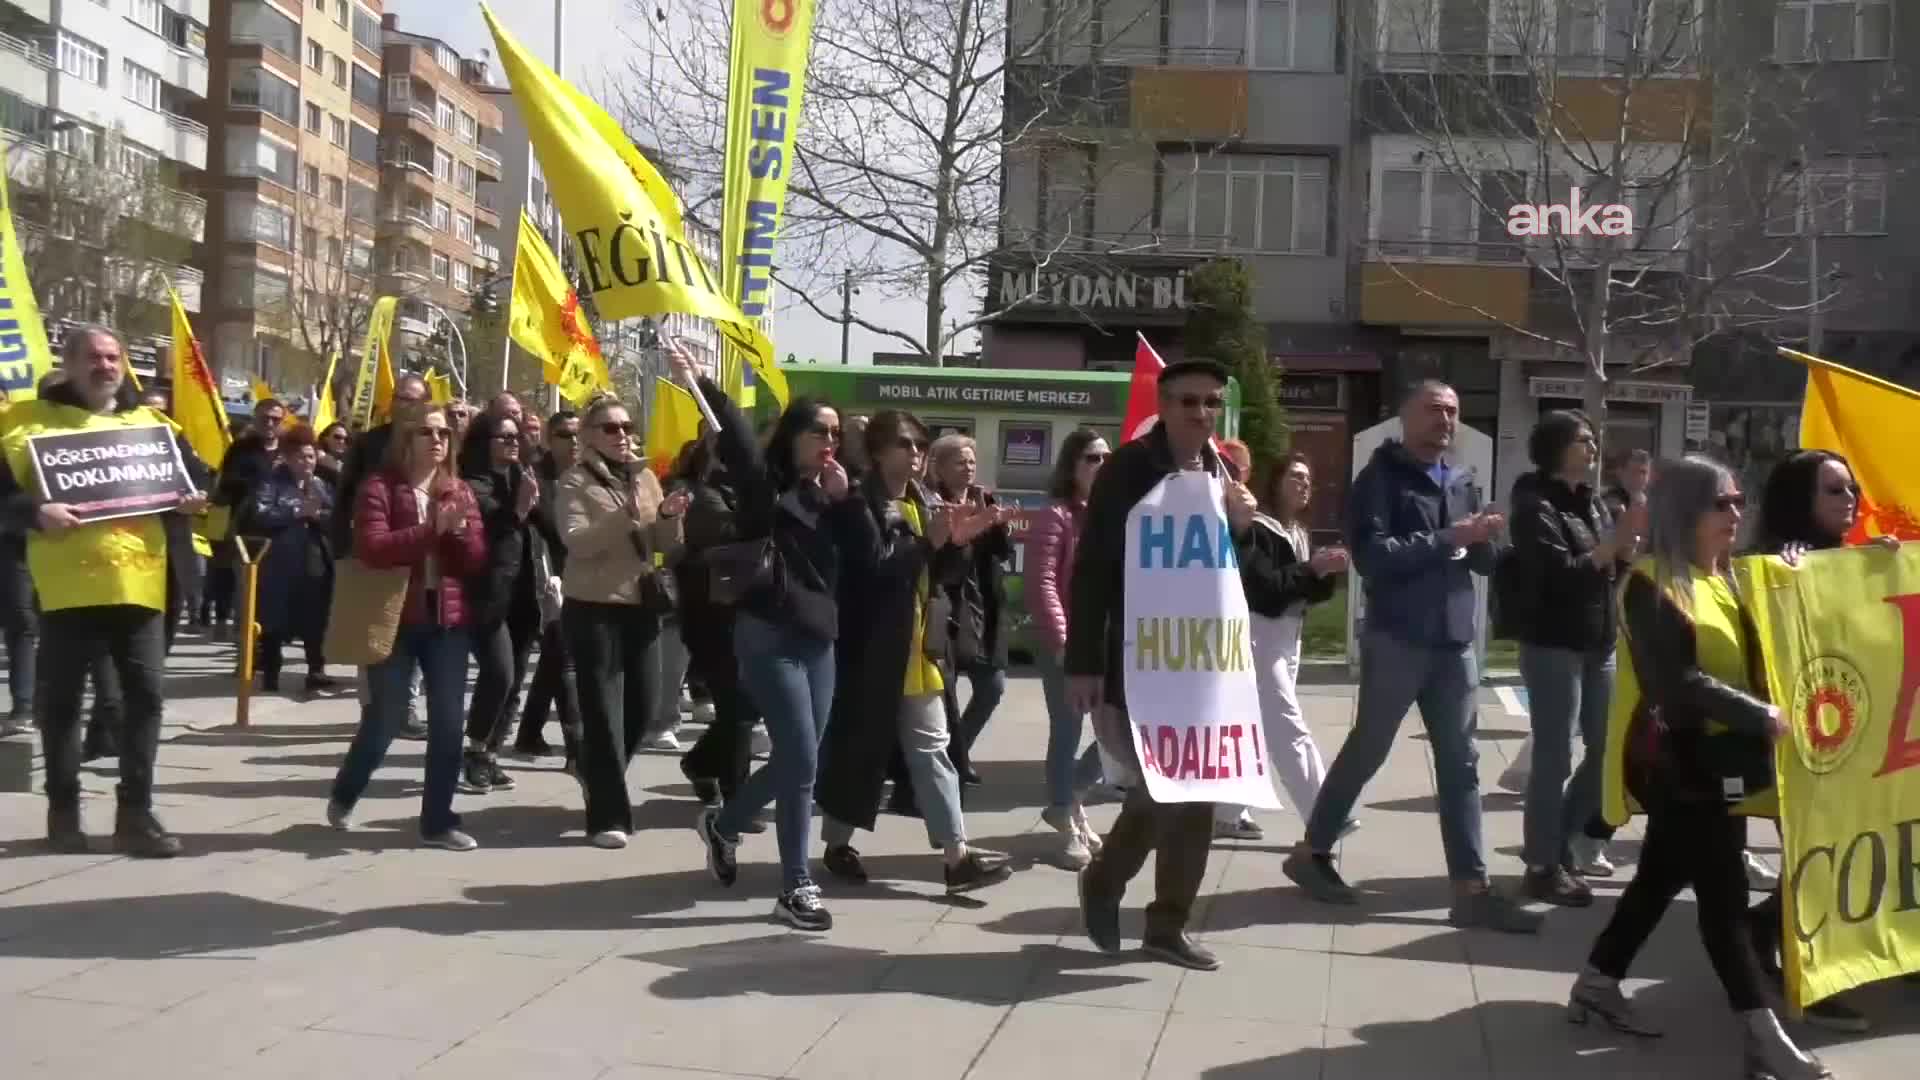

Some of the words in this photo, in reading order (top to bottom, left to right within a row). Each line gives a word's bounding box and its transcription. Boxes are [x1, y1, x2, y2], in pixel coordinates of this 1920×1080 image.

[748, 67, 791, 181] SEN
[1000, 271, 1137, 308] MEYDAN
[879, 384, 922, 398] MOBİL
[927, 386, 958, 400] ATIK
[962, 386, 1025, 402] GETİRME
[1028, 389, 1090, 405] MERKEZİ
[56, 462, 173, 491] DOKUNMA!!
